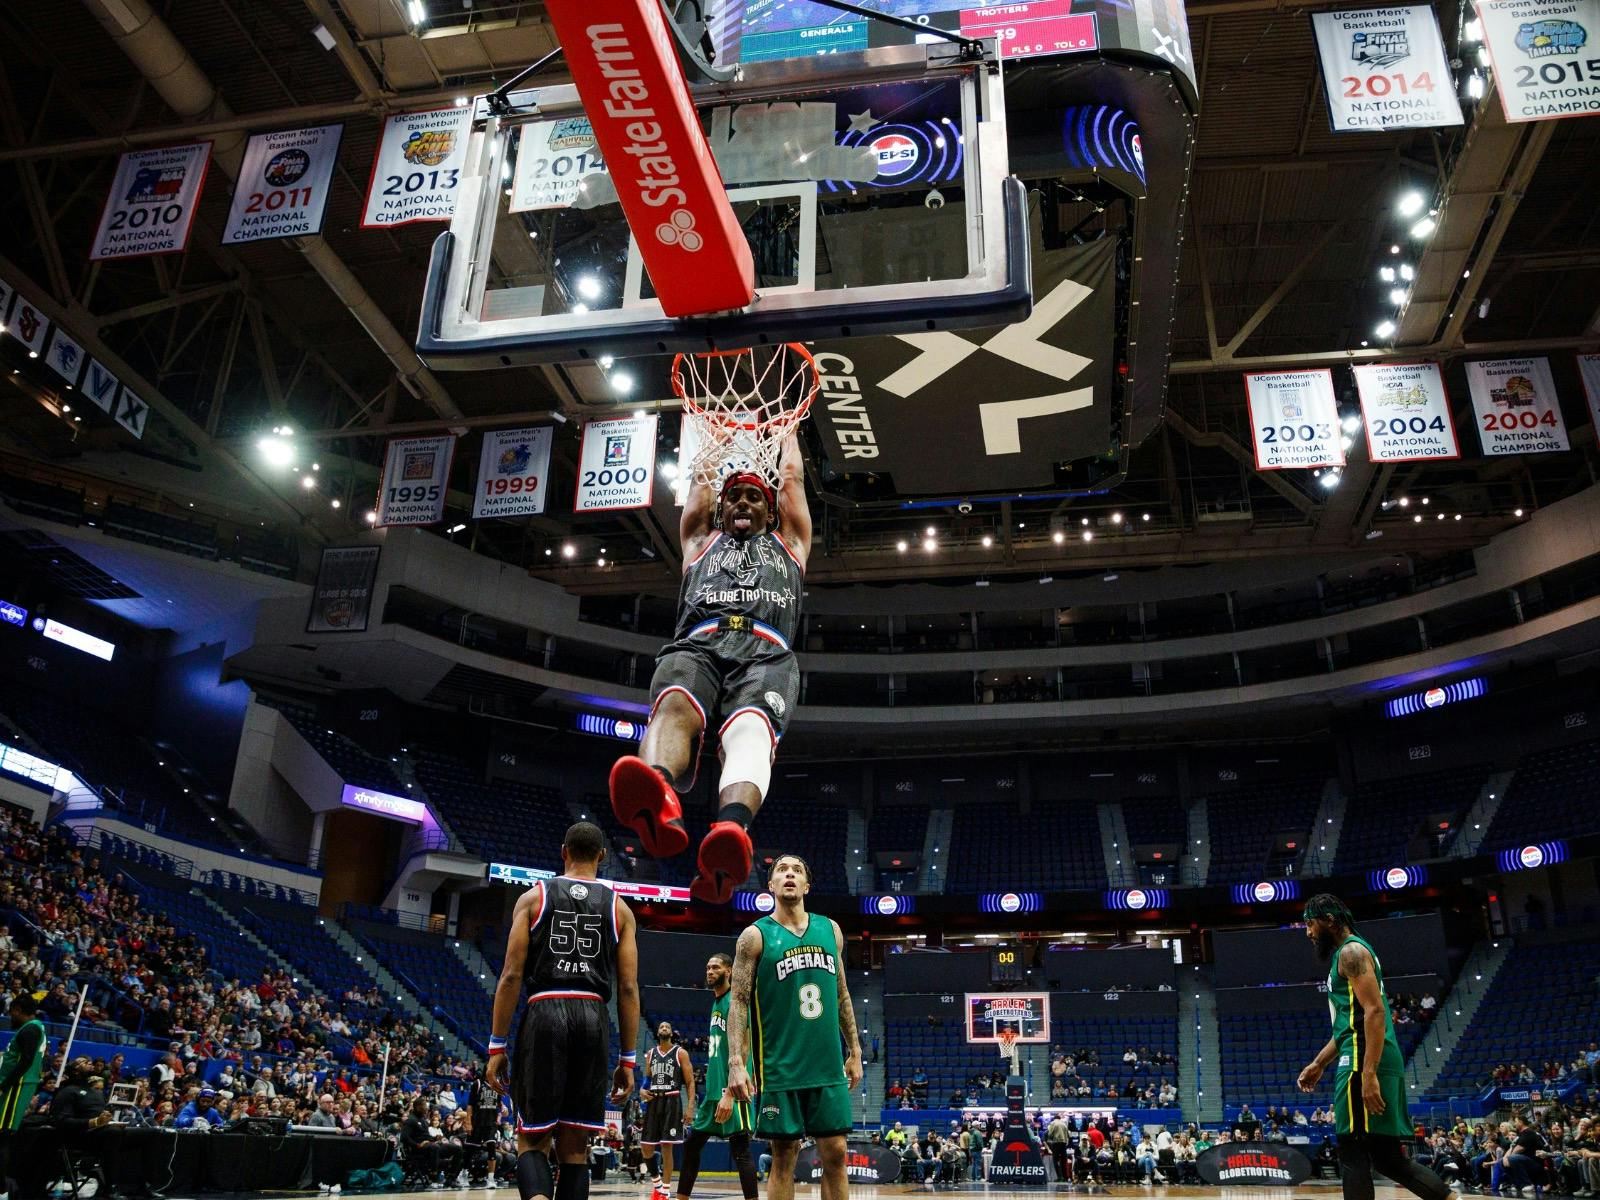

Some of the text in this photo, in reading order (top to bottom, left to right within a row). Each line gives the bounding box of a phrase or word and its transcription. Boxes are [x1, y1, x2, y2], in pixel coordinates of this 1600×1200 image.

[975, 5, 1029, 17] TROTTERS
[1490, 1, 1531, 10] UConn
[1333, 8, 1411, 20] UConn Men's
[1512, 6, 1576, 18] Basketball
[1343, 19, 1405, 30] Basketball
[801, 26, 853, 38] GENERALS
[1366, 32, 1407, 45] FINAL
[1011, 45, 1031, 54] FLS
[1054, 40, 1076, 49] TOL
[1513, 59, 1600, 88] 2015
[1342, 72, 1435, 98] 2014
[1351, 99, 1435, 112] NATIONAL
[394, 107, 472, 123] UConn Women'
[1347, 111, 1446, 126] CHAMPIONS
[407, 118, 459, 131] Basketball
[265, 127, 327, 142] UConn Men's
[268, 138, 318, 150] Basketball
[879, 148, 916, 161] EPSI
[139, 156, 187, 167] Basketball
[383, 169, 459, 196] 2013
[245, 187, 312, 214] 2011
[384, 195, 452, 209] NATIONAL
[108, 204, 183, 231] 2010
[241, 211, 306, 226] NATIONAL
[375, 205, 454, 223] CHAMPIONS
[109, 229, 172, 243] NATIONAL
[233, 222, 309, 240] CHAMPIONS
[101, 240, 174, 256] CHAMPIONS
[1393, 364, 1432, 373] Women's
[1479, 361, 1508, 369] UConn
[1284, 372, 1321, 381] Women's
[1378, 374, 1420, 382] Basketball
[1267, 381, 1310, 389] Basketball
[812, 352, 880, 459] CENTER
[1372, 416, 1446, 437] 2004
[1483, 410, 1557, 431] 2004
[601, 427, 639, 435] Basketball
[1262, 423, 1332, 443] 2003
[1495, 432, 1553, 441] NATIONAL
[1383, 437, 1441, 447] NATIONAL
[1492, 442, 1560, 453] CHAMPIONS
[1271, 444, 1327, 454] NATIONAL
[1381, 447, 1448, 458] CHAMPIONS
[1267, 454, 1333, 465] CHAMPIONS
[583, 467, 647, 487] 2000
[485, 476, 538, 495] 1999
[389, 485, 440, 503] 1995
[589, 487, 639, 497] NATIONAL
[486, 496, 533, 506] NATIONAL
[584, 497, 642, 508] CHAMPIONS
[388, 504, 436, 514] NATIONAL
[480, 505, 536, 516] CHAMPIONS
[383, 513, 438, 524] CHAMPIONS
[706, 588, 787, 609] GLOBETROTTERS
[360, 710, 378, 720] 220
[498, 867, 511, 877] 34
[658, 888, 671, 898] 39
[549, 909, 602, 957] 55
[785, 946, 823, 957] WASHINGTON
[557, 959, 590, 973] CRASH
[776, 953, 836, 982] GENERALS
[1317, 985, 1328, 993] 12
[799, 983, 823, 1020] 8
[991, 1000, 1025, 1010] HARLEM
[985, 1009, 1032, 1019] GLOBETROTTERS
[845, 1152, 869, 1167] LEM
[1227, 1154, 1278, 1168] HARLEM
[991, 1165, 1044, 1175] TRAVELERS
